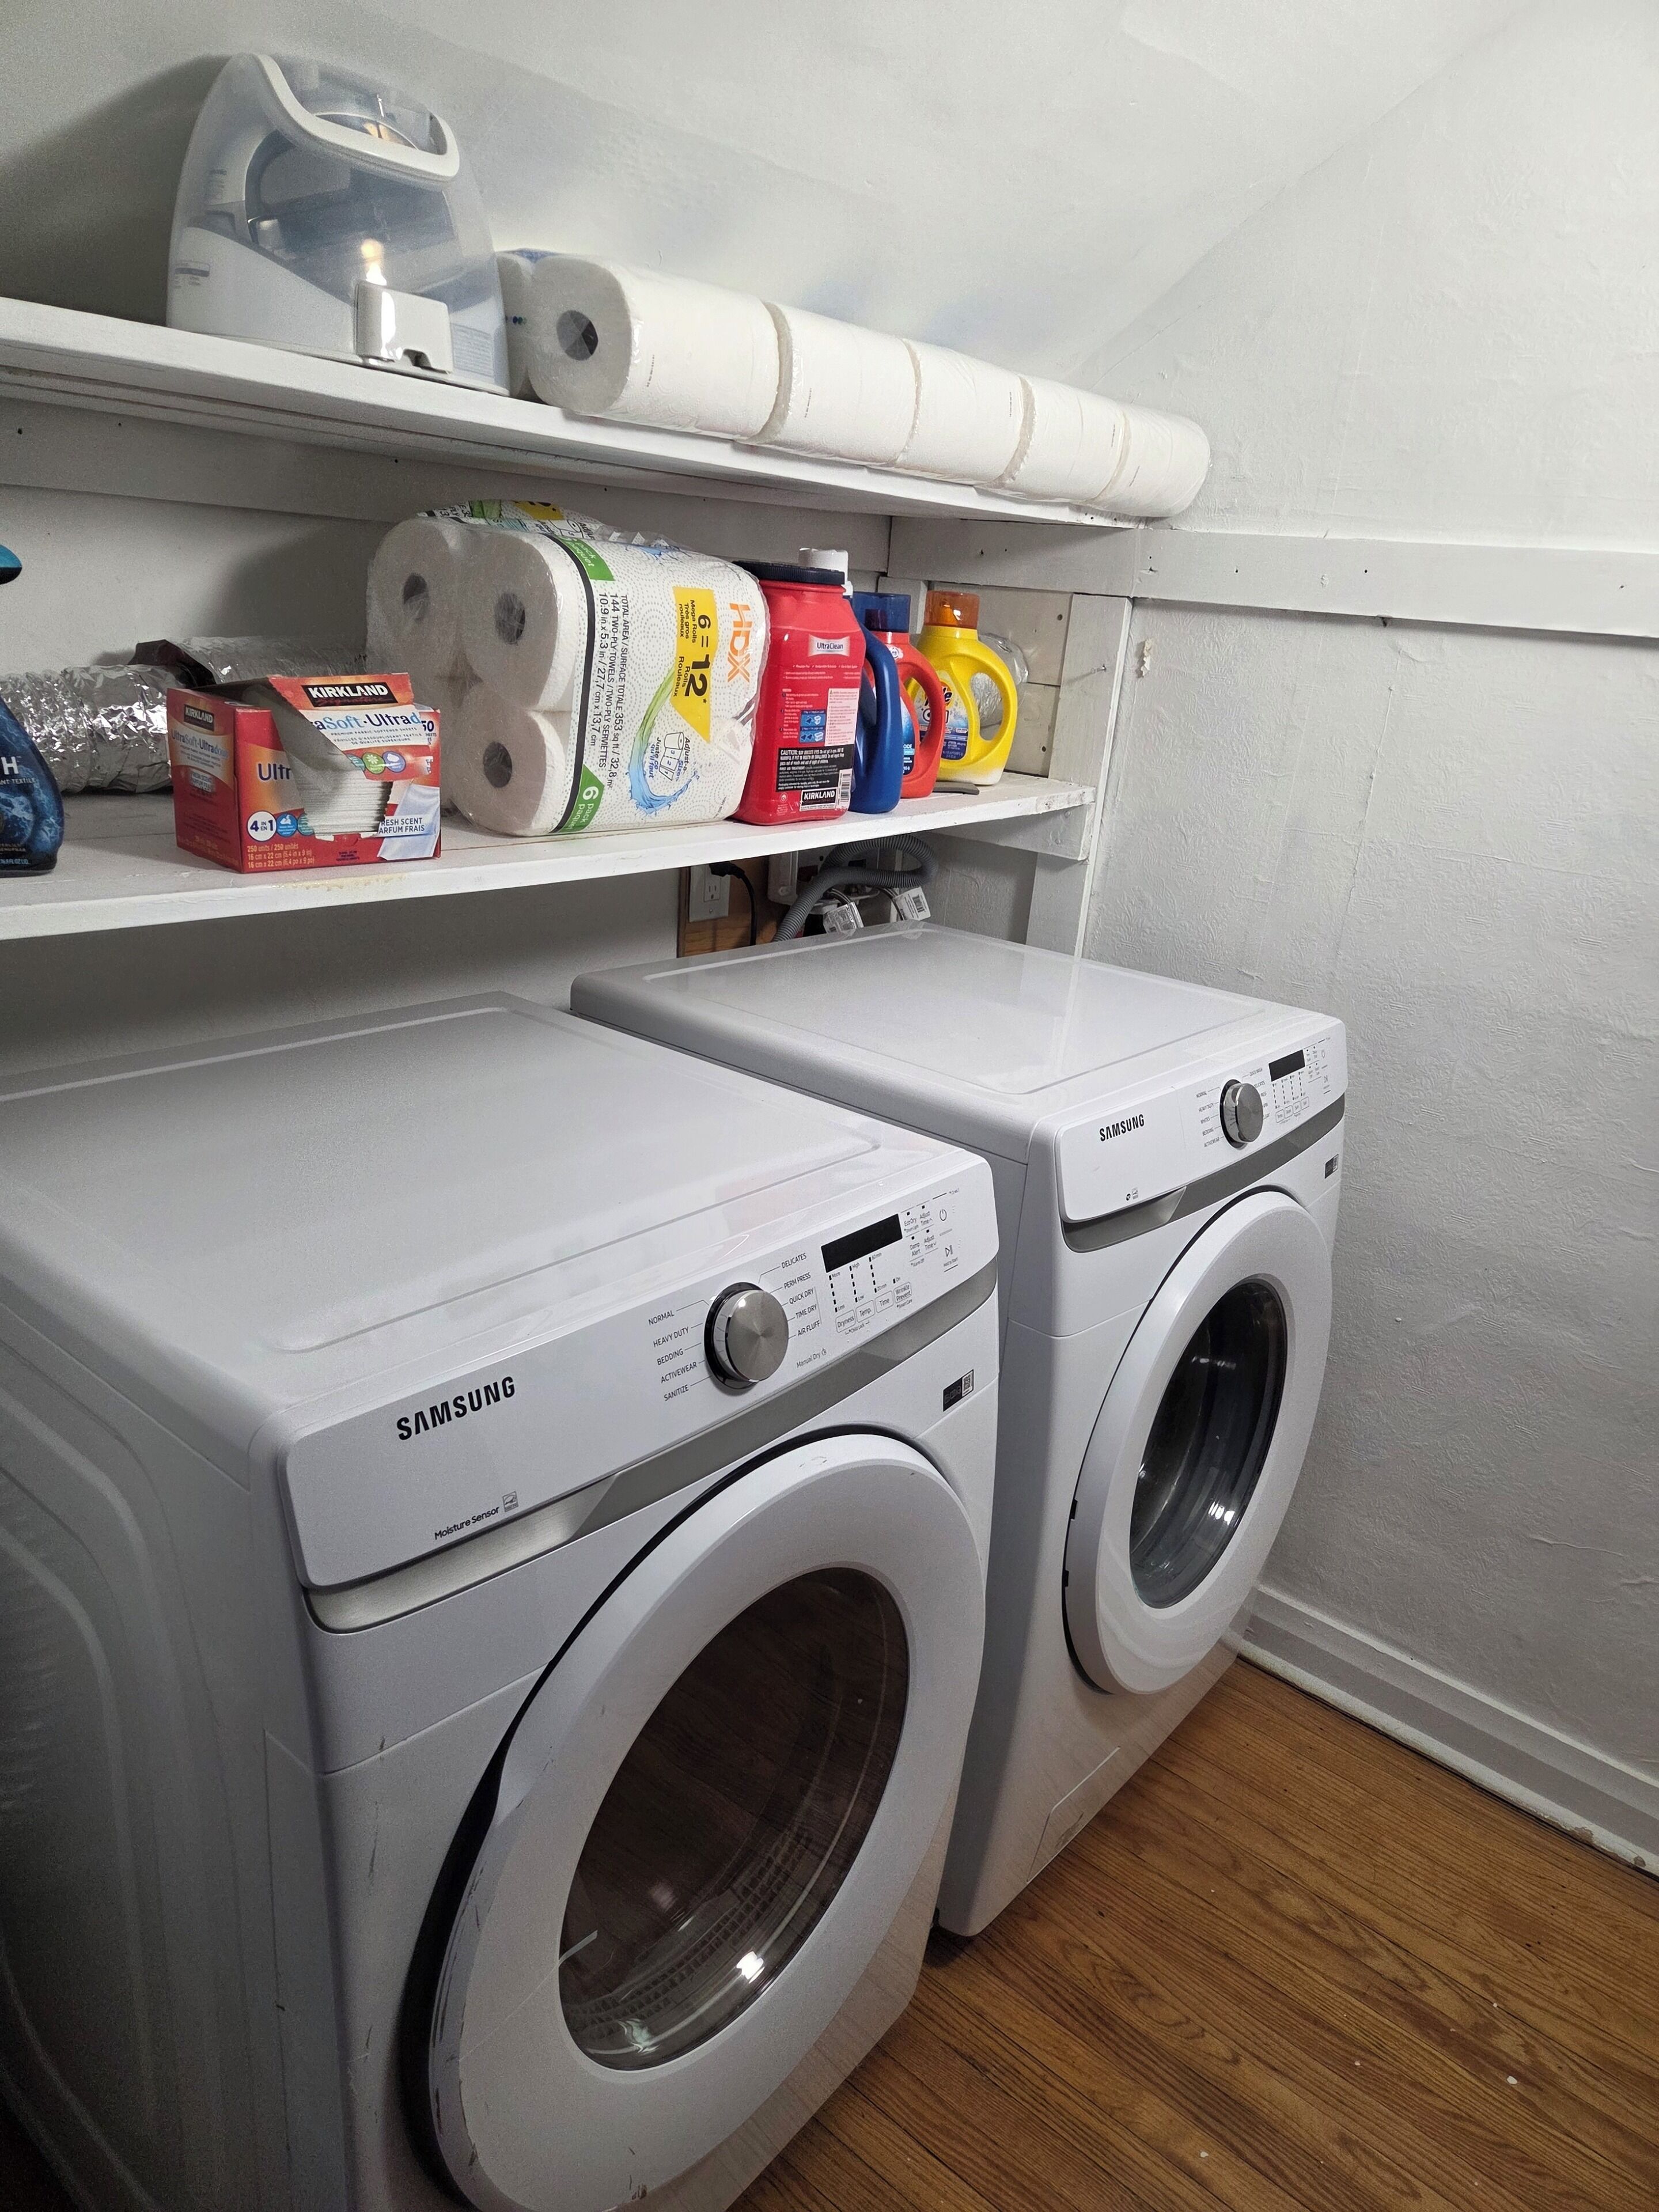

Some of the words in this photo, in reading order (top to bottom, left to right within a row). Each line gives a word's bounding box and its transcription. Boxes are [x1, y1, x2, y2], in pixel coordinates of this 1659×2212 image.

[599, 592, 609, 615] 10.9
[610, 593, 620, 613] 144
[620, 594, 629, 618] TOTAL
[600, 616, 608, 624] in
[698, 615, 711, 629] 6
[611, 615, 619, 650] TWO-PLY
[622, 619, 630, 641] AREA
[600, 633, 609, 649] 5.3
[728, 603, 753, 683] HDX
[817, 642, 844, 650] UltraClean
[607, 652, 617, 683] TOWELS
[619, 647, 628, 683] SURFACE
[595, 667, 607, 690] 27,7
[673, 656, 685, 697] Rouleaux
[681, 666, 691, 688] Rolls
[308, 685, 389, 699] KIRKLAND
[594, 691, 601, 703] cm
[616, 683, 625, 711] TOTALE
[185, 707, 213, 724] KIRKLAND
[604, 690, 613, 723] TWO-PLY
[590, 712, 602, 733] 13,7
[614, 713, 624, 731] 353
[590, 734, 597, 747] cm
[612, 732, 620, 741] sq
[599, 724, 610, 768] SERVIETTES
[608, 757, 620, 778] 32,8
[582, 786, 599, 800] 6
[804, 790, 835, 800] KIRKLAND
[381, 818, 399, 826] RESH
[401, 817, 423, 825] SCENT
[579, 803, 594, 823] pack
[250, 820, 259, 832] 4
[268, 820, 274, 831] 1
[378, 826, 403, 834] ARFUM
[405, 824, 425, 833] FRAIS
[1099, 1113, 1145, 1142] SAMSUNG
[781, 1252, 807, 1268] DELICATES
[783, 1279, 797, 1290] PERM
[797, 1272, 812, 1283] PRESS
[789, 1292, 804, 1305] QUICK
[804, 1287, 815, 1297] DRY
[879, 1298, 890, 1307] Time
[648, 1310, 675, 1326] NORMAL
[796, 1310, 808, 1319] TIME
[807, 1304, 817, 1313] DRY
[797, 1327, 806, 1337] AIR
[806, 1320, 821, 1332] FLUFF
[837, 1315, 855, 1328] Dryness
[653, 1333, 673, 1348] HEAVY
[673, 1326, 690, 1339] DUTY
[657, 1348, 684, 1365] BEDDING
[661, 1361, 697, 1384] ACTIVEWEAR
[664, 1384, 689, 1402] SANITIZE
[396, 1376, 515, 1441] SAMSUNG
[434, 1518, 471, 1540] Moisture
[471, 1506, 500, 1524] Sensor
